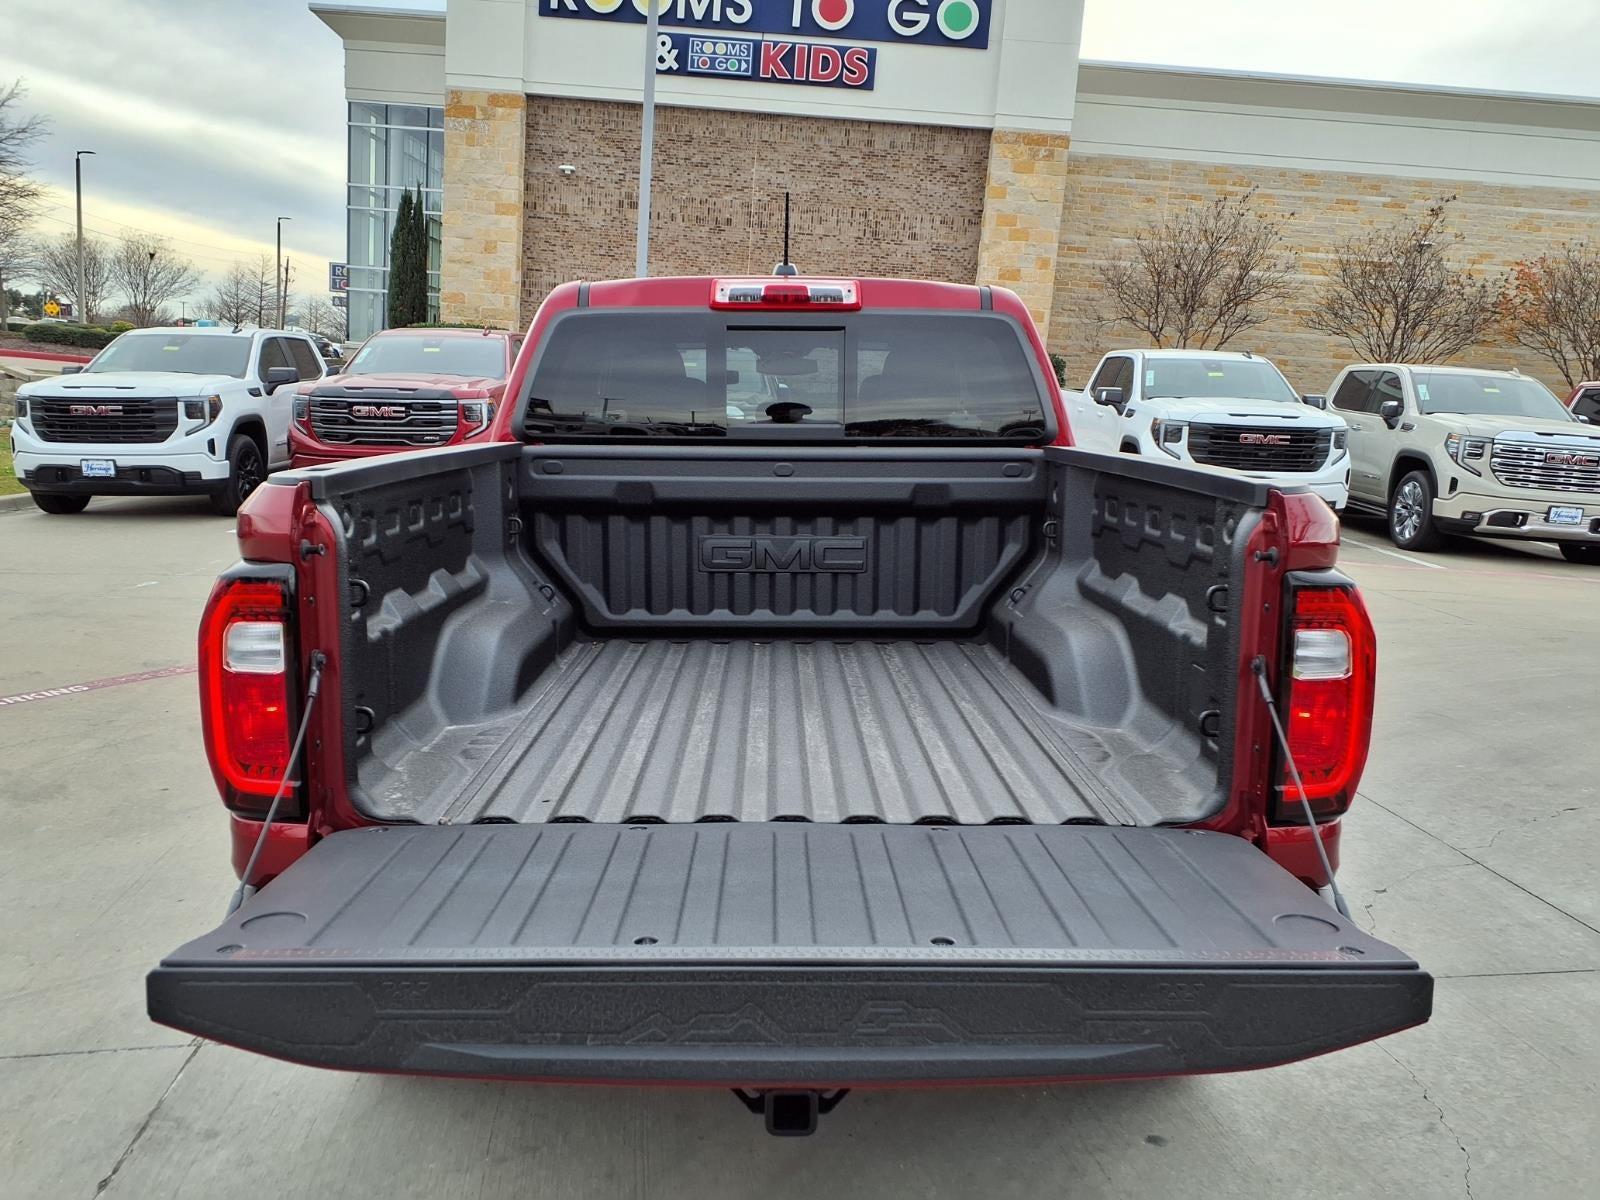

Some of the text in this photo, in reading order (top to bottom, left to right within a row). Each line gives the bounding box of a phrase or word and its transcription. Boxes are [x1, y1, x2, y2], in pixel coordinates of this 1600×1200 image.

[887, 0, 980, 40] GO
[693, 41, 747, 56] ROOMS
[692, 56, 738, 71] TO GO
[760, 41, 869, 85] KIDS
[70, 405, 123, 416] GMC
[352, 405, 405, 417] GMC
[1240, 433, 1290, 445] GMC
[1547, 453, 1599, 467] GMC
[702, 538, 865, 570] GMC
[0, 685, 89, 705] RKING
